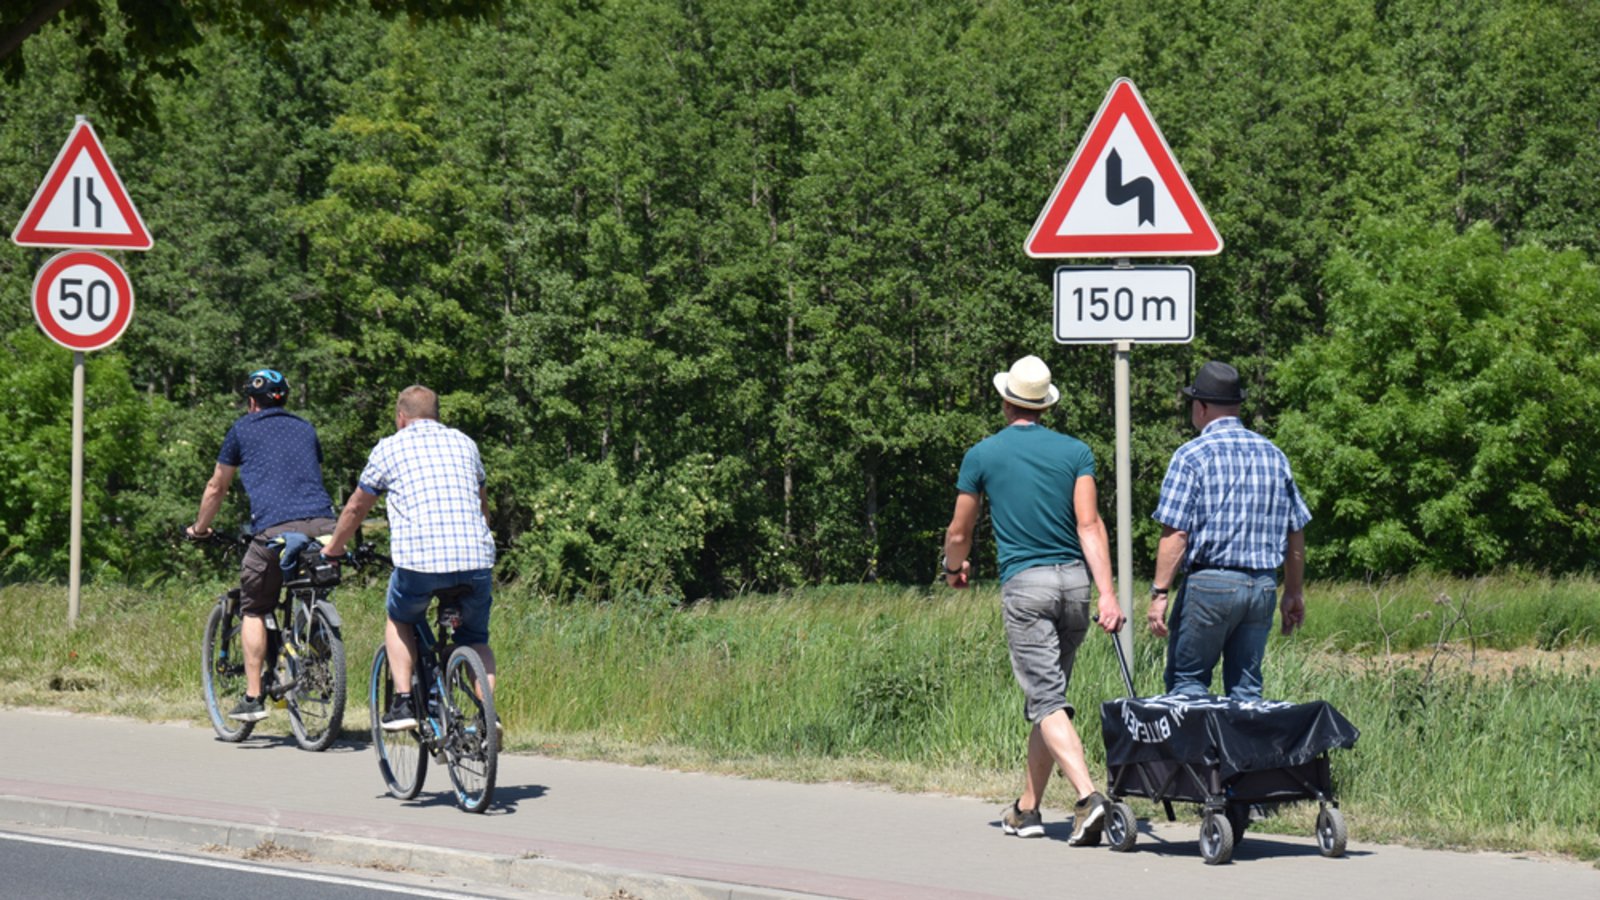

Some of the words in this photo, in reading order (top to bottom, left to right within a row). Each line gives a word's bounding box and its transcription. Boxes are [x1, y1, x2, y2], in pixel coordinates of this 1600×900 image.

[59, 278, 111, 322] 50
[1072, 286, 1134, 322] 150
[1142, 296, 1176, 321] m
